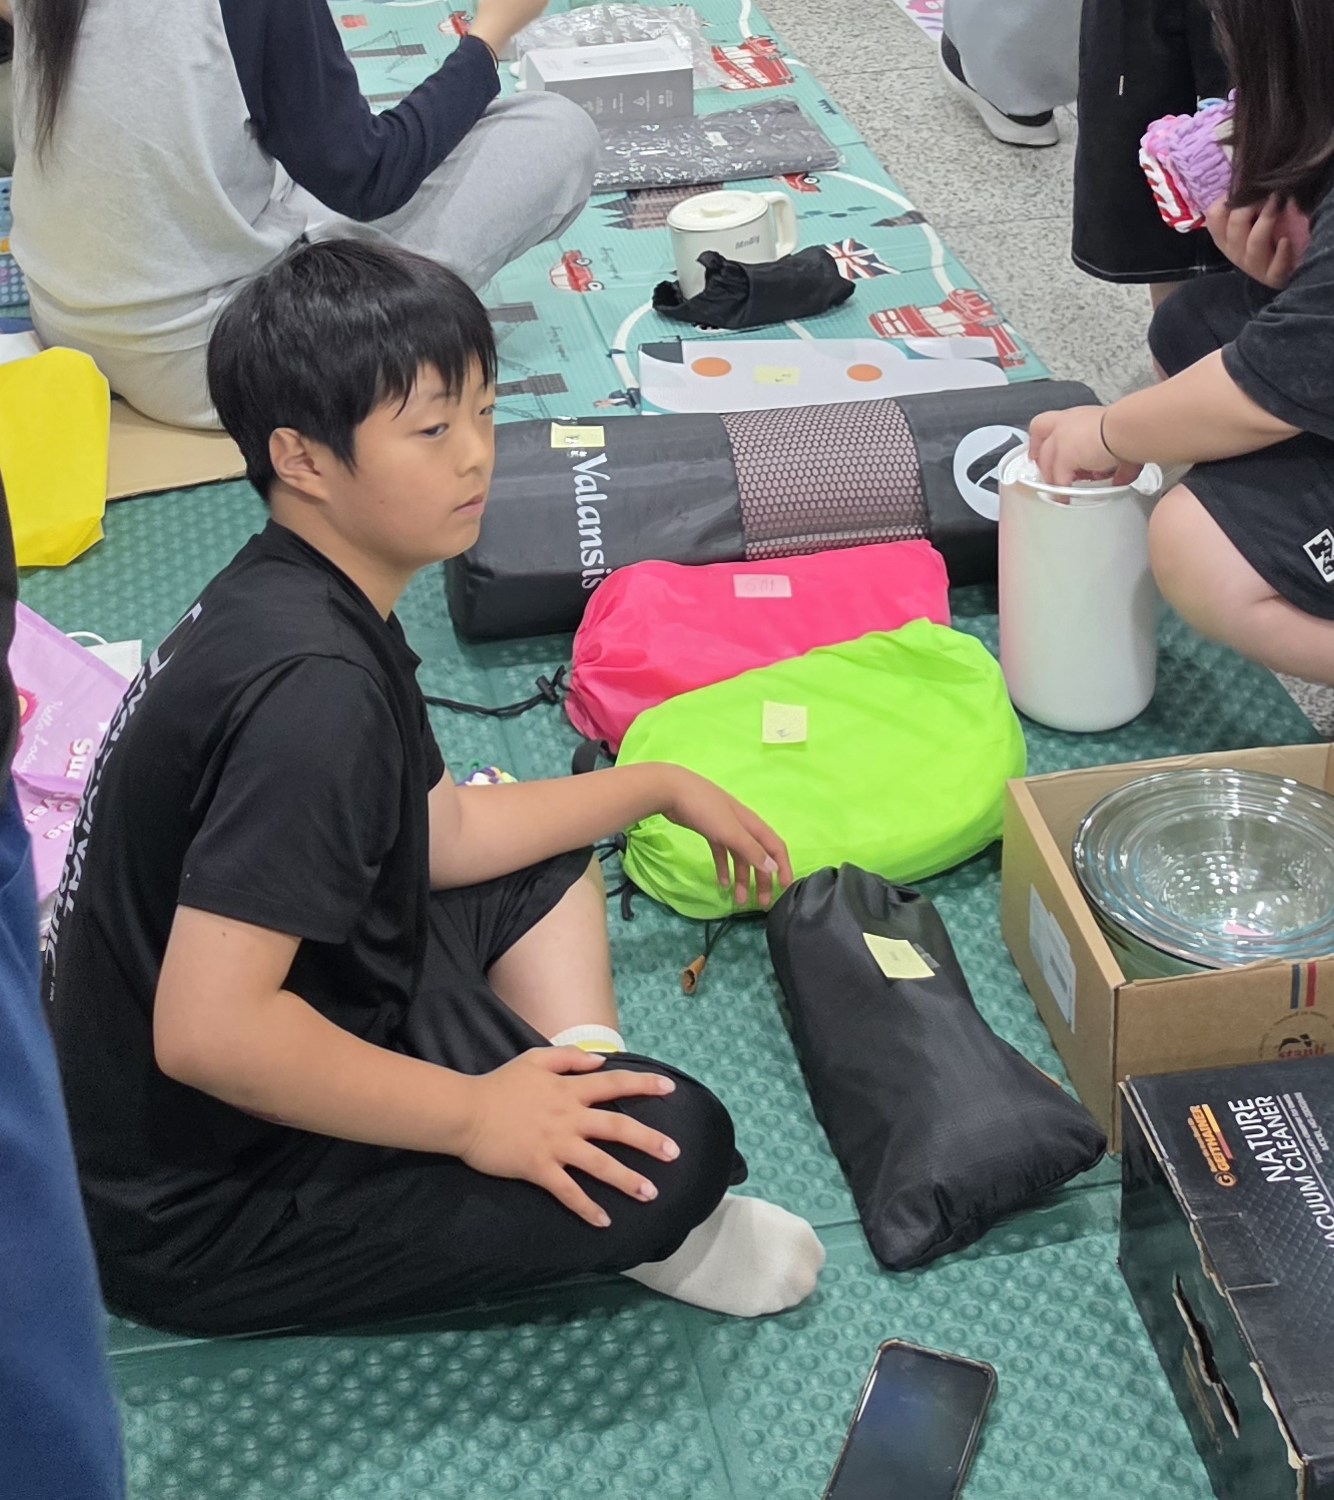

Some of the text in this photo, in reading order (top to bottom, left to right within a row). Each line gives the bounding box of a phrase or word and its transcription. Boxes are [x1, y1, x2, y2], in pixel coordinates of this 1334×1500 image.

[1189, 1105, 1231, 1172] GEITHAINER
[1227, 1098, 1291, 1182] NATURE
[1254, 1095, 1307, 1172] CLEANER
